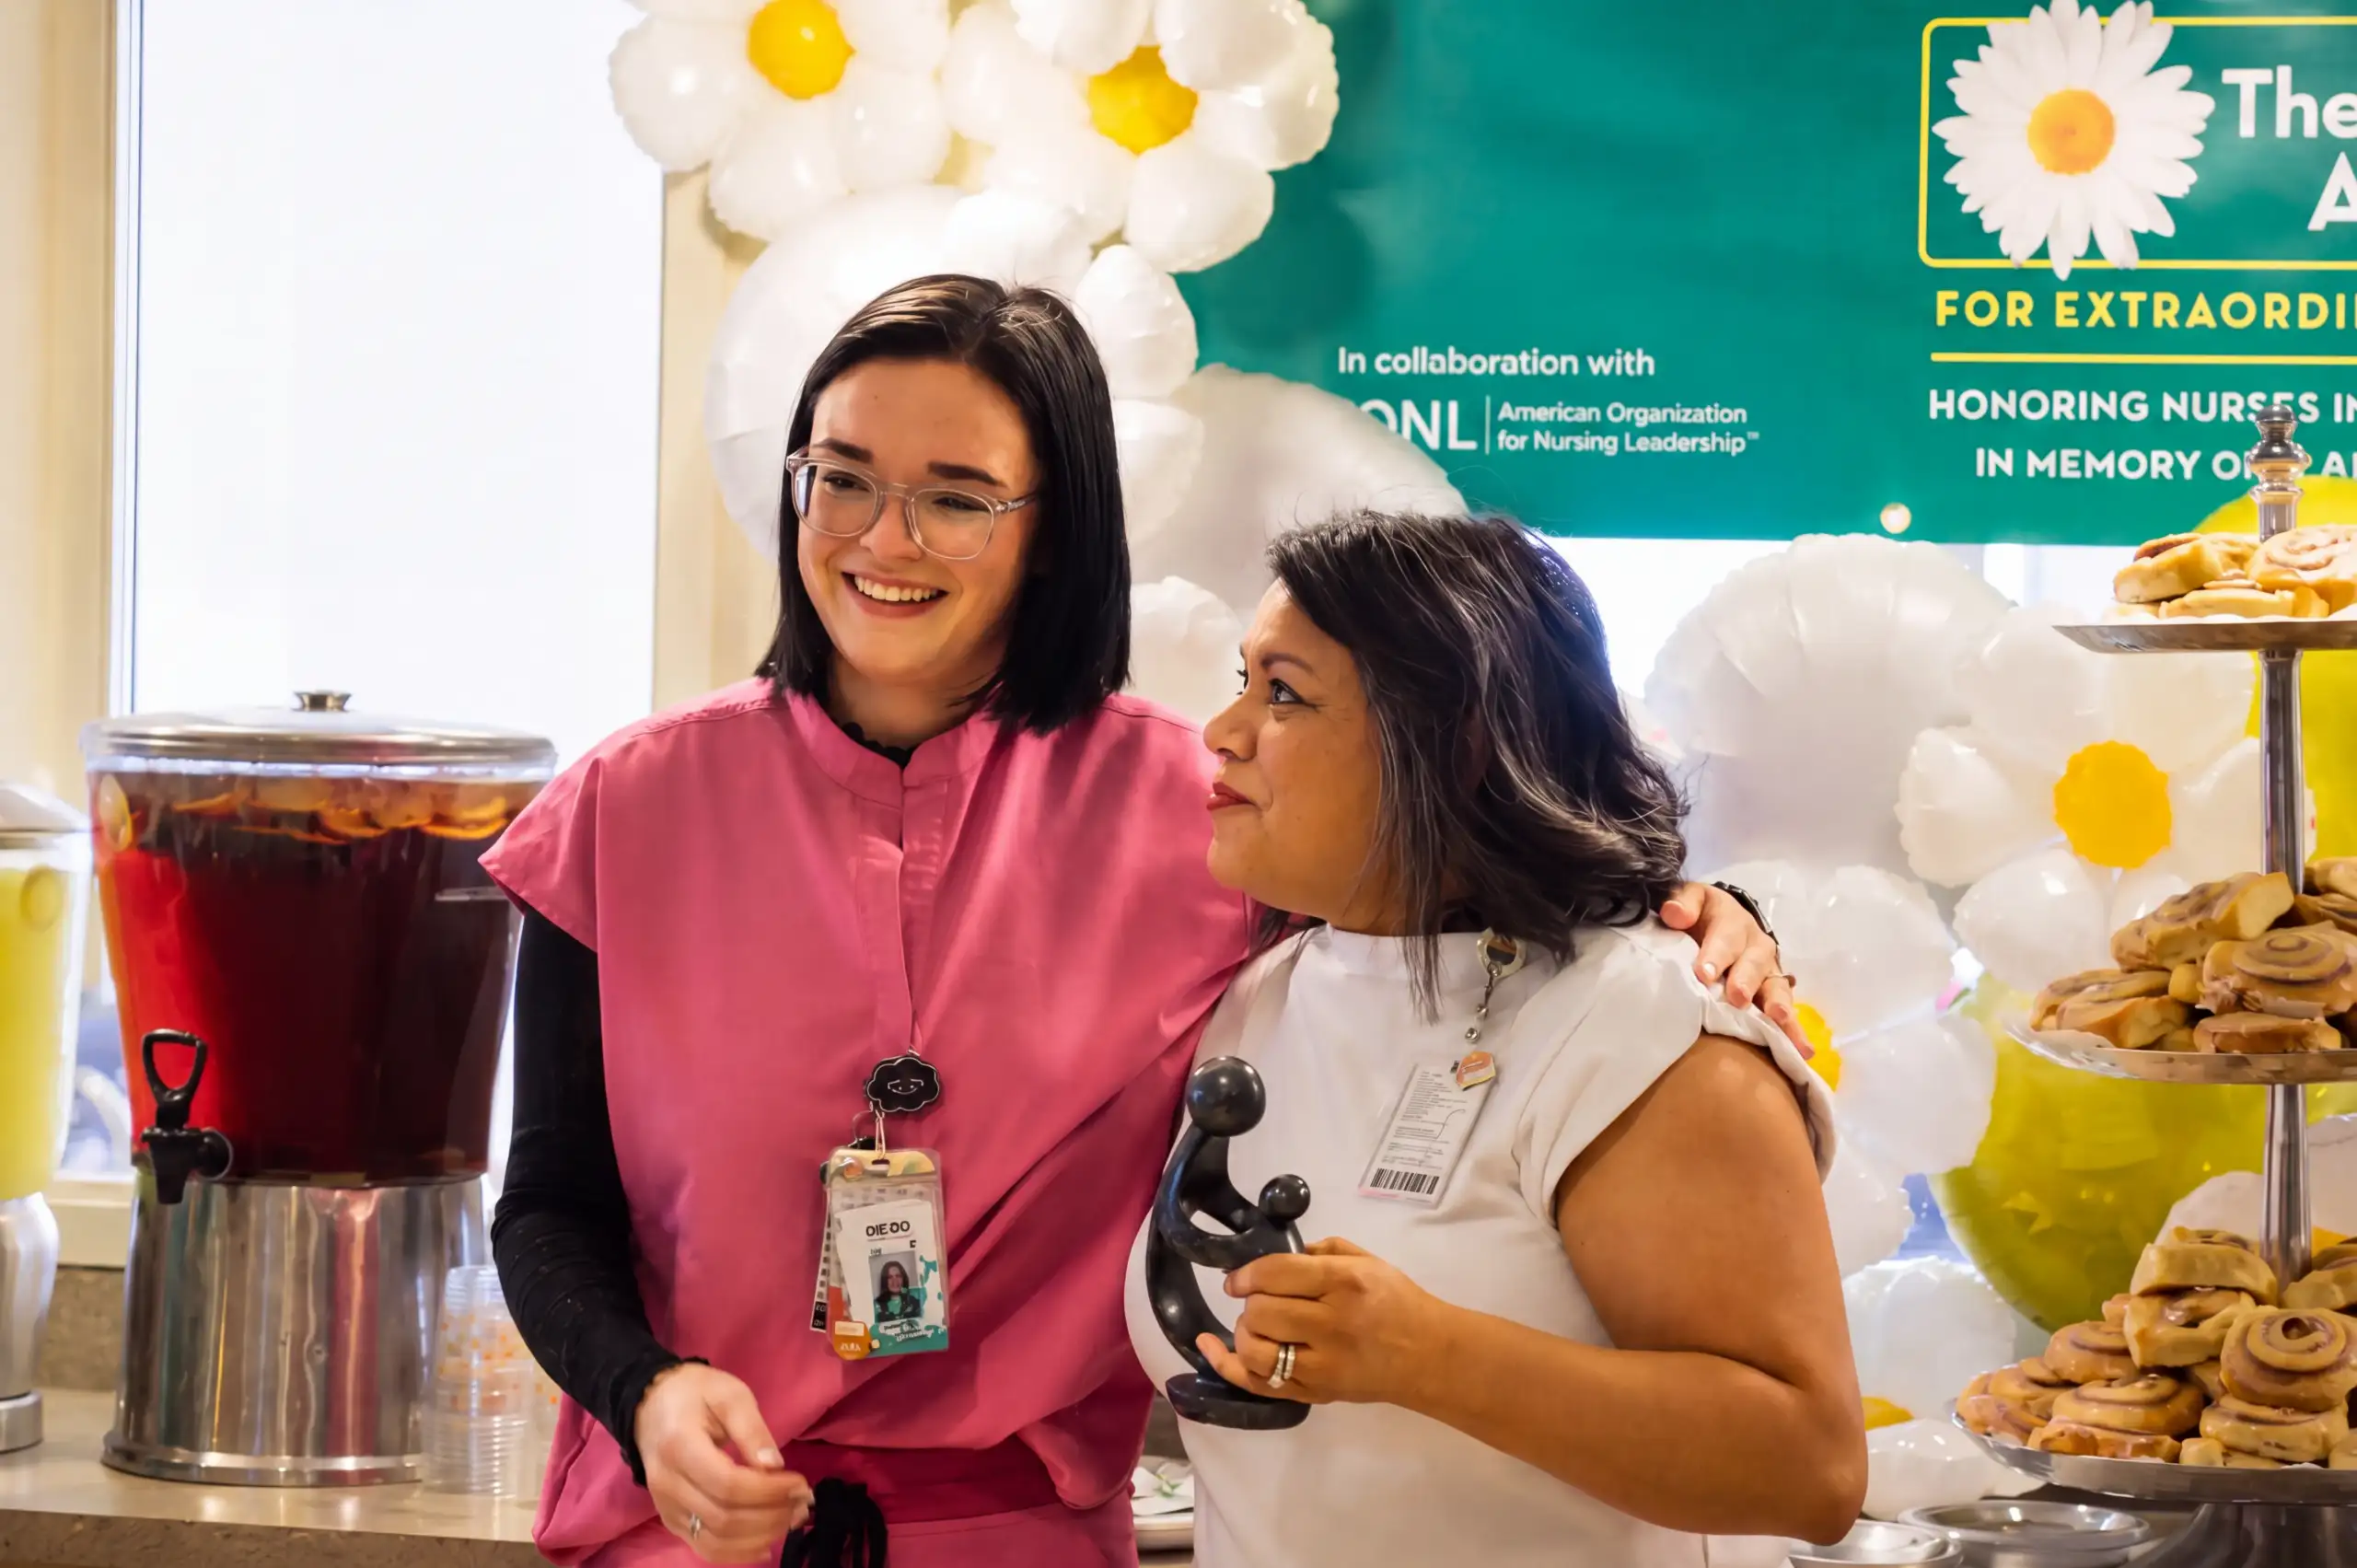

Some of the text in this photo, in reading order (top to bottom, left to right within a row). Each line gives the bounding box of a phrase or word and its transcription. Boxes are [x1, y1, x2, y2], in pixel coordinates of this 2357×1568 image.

[2221, 64, 2357, 140] The
[1936, 290, 2357, 330] FOR EXTRAORDI
[1338, 346, 1656, 376] In collaboration with
[1497, 401, 1747, 426] American Organization
[1929, 389, 2149, 422] HONORING
[1497, 430, 1528, 450] for
[1534, 430, 1619, 456] Nursing
[1976, 447, 2014, 477] IN
[2026, 449, 2201, 481] MEMORY
[2320, 451, 2357, 478] A
